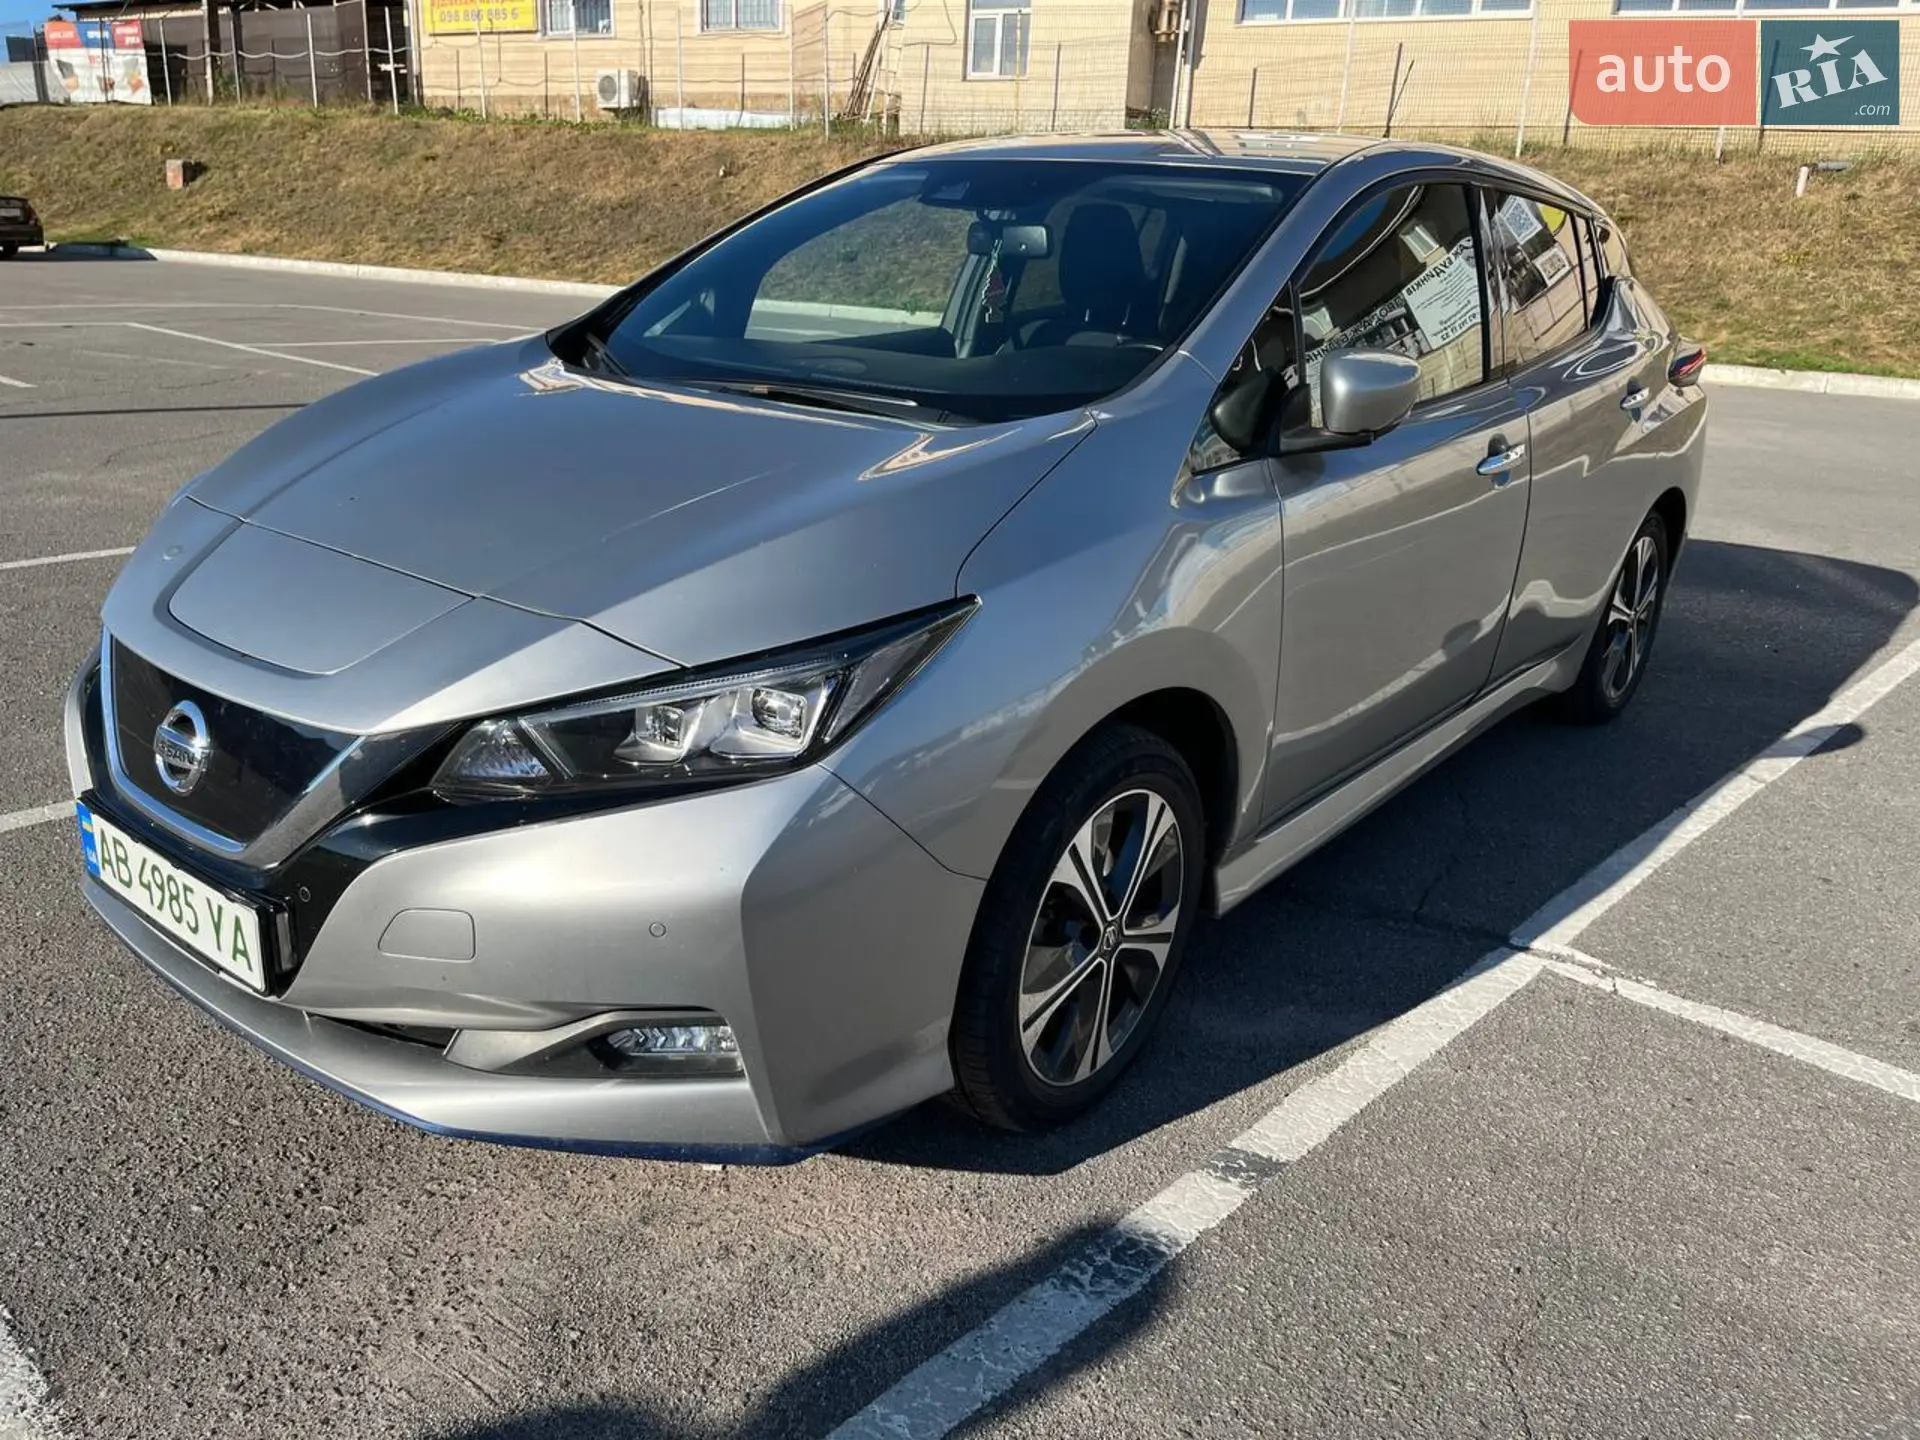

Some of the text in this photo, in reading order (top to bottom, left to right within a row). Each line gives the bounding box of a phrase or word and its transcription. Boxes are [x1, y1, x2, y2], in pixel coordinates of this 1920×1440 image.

[100, 827, 253, 972] AB 4985 YA
